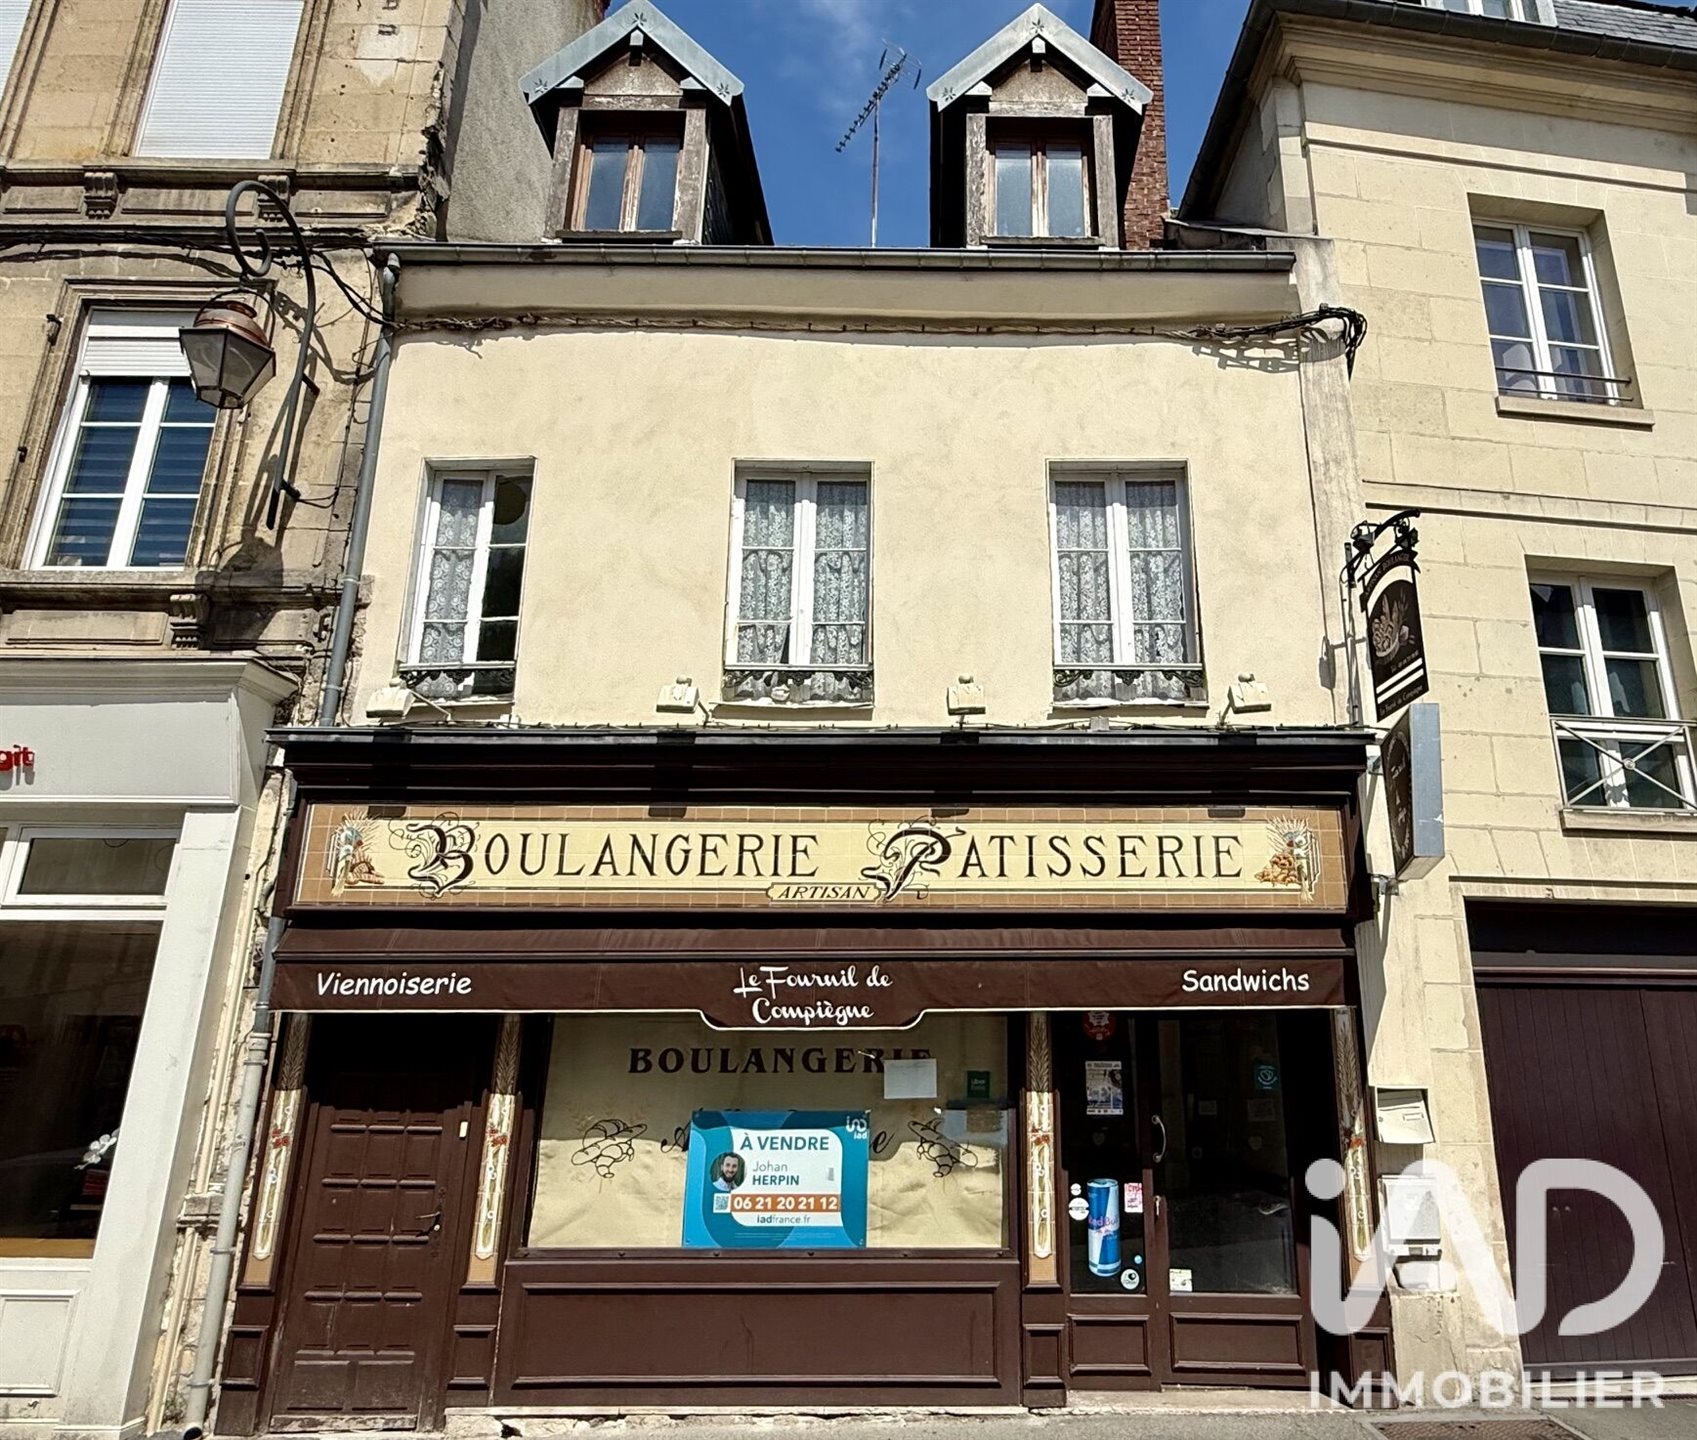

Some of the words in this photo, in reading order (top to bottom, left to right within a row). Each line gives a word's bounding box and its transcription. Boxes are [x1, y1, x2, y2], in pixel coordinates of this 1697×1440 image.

[392, 815, 819, 899] BOULANGERIE
[863, 817, 1243, 902] PATISSERIE
[777, 886, 871, 900] ARTISAN
[317, 972, 472, 996] Viennoiserie
[733, 967, 763, 998] Le
[759, 965, 859, 999] Fournil
[866, 965, 893, 987] de
[1182, 968, 1310, 992] Sandwichs
[752, 998, 874, 1026] Compiègne
[740, 1132, 753, 1150] À
[758, 1136, 829, 1150] VENDRE
[853, 1132, 867, 1140] iad
[752, 1160, 788, 1172] Johan
[752, 1175, 800, 1185] HERPIN
[733, 1197, 752, 1209] 06
[755, 1197, 772, 1209] 21
[777, 1197, 795, 1209] 20
[798, 1197, 815, 1209] 21
[819, 1197, 838, 1210] 12
[757, 1214, 811, 1224] iadfrance.fr
